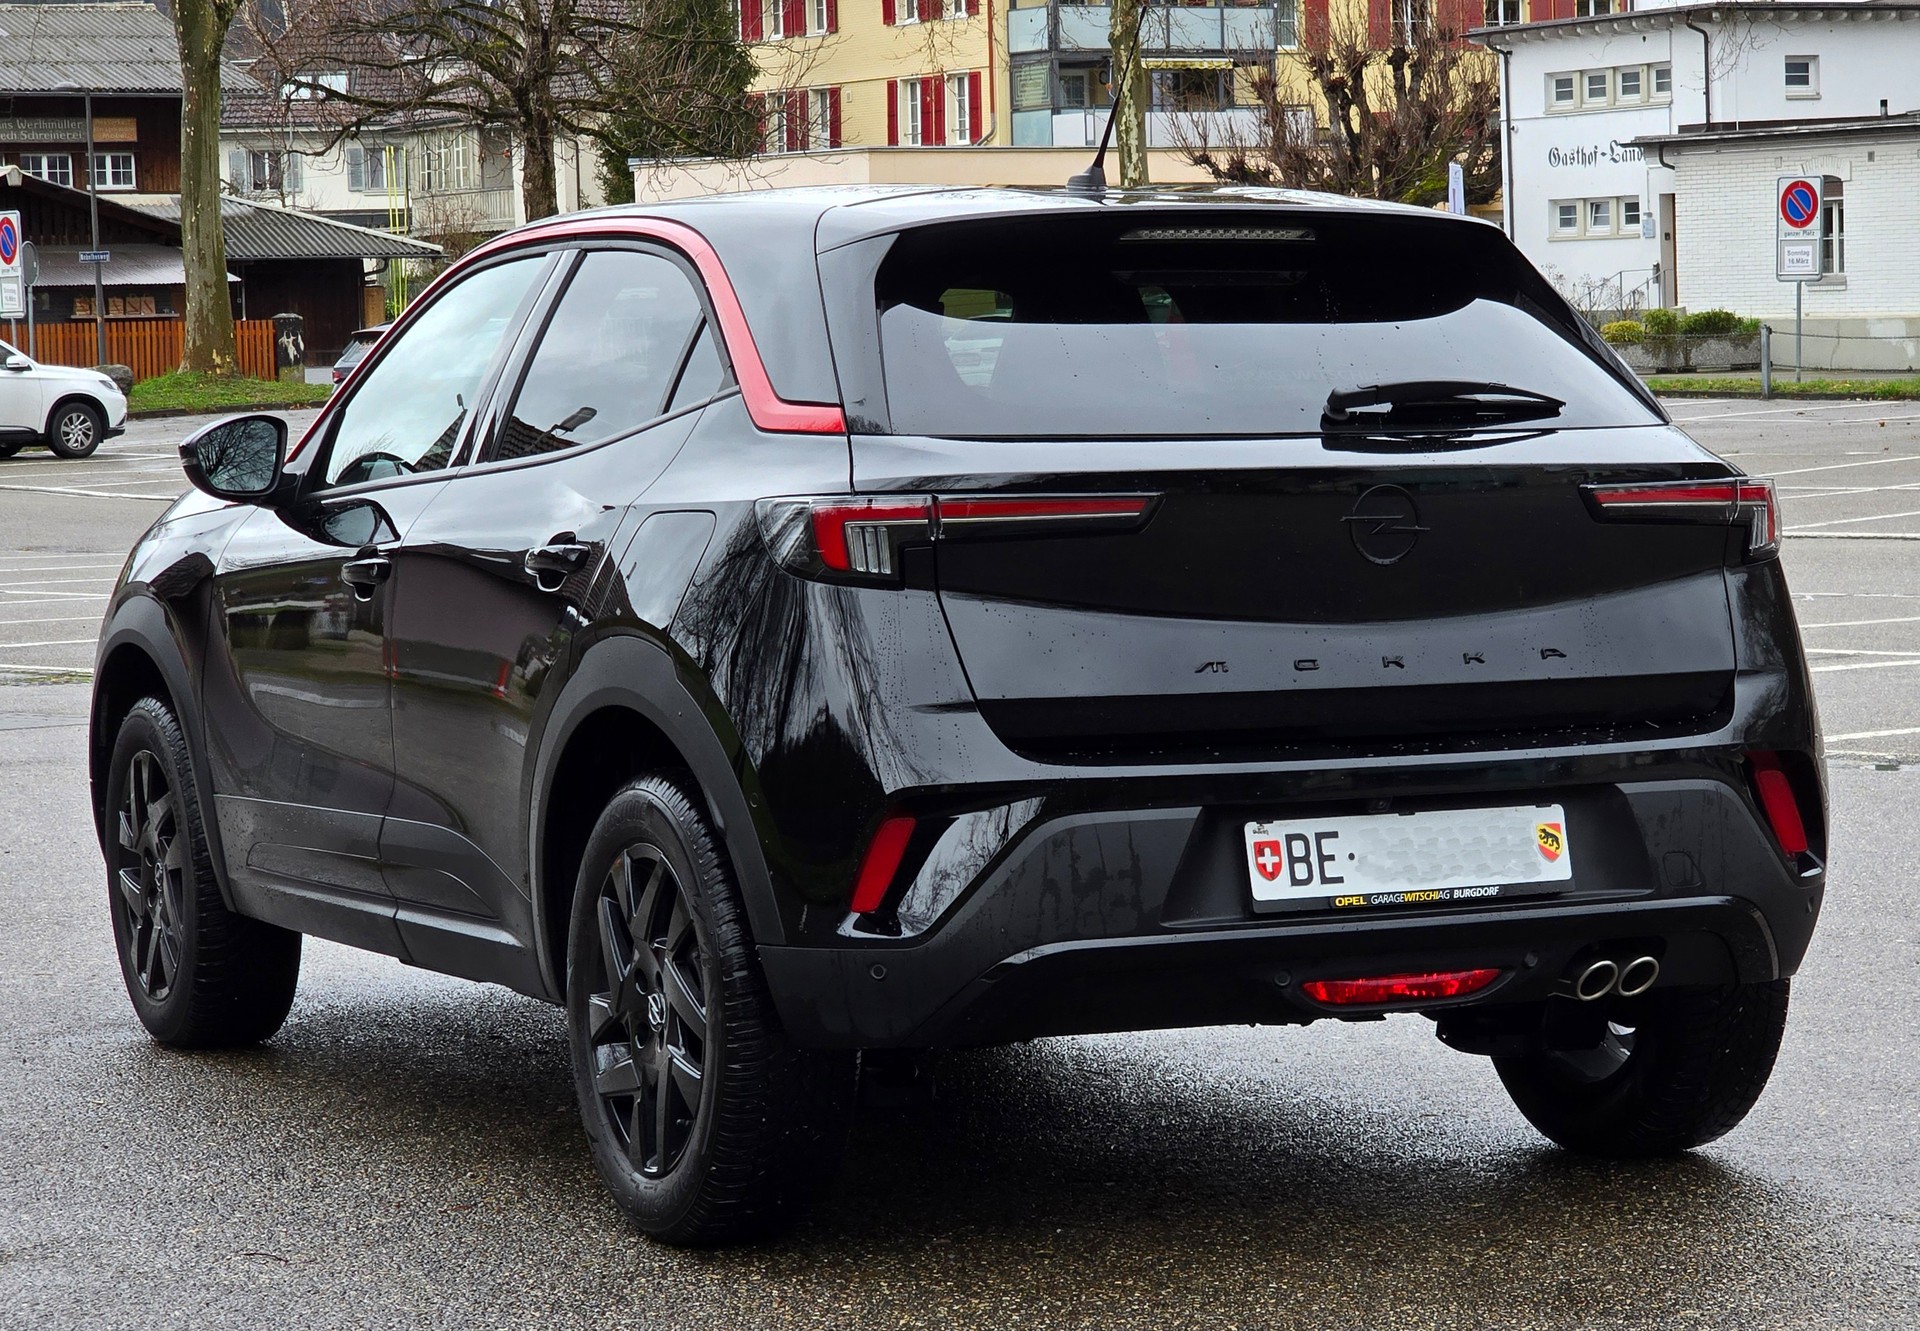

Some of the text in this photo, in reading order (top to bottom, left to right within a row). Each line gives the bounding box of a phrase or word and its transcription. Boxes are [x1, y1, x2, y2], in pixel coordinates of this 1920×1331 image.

[1195, 648, 1567, 674] MOKKA
[1335, 896, 1367, 907] OPEL
[1453, 886, 1500, 899] BURGDORF
